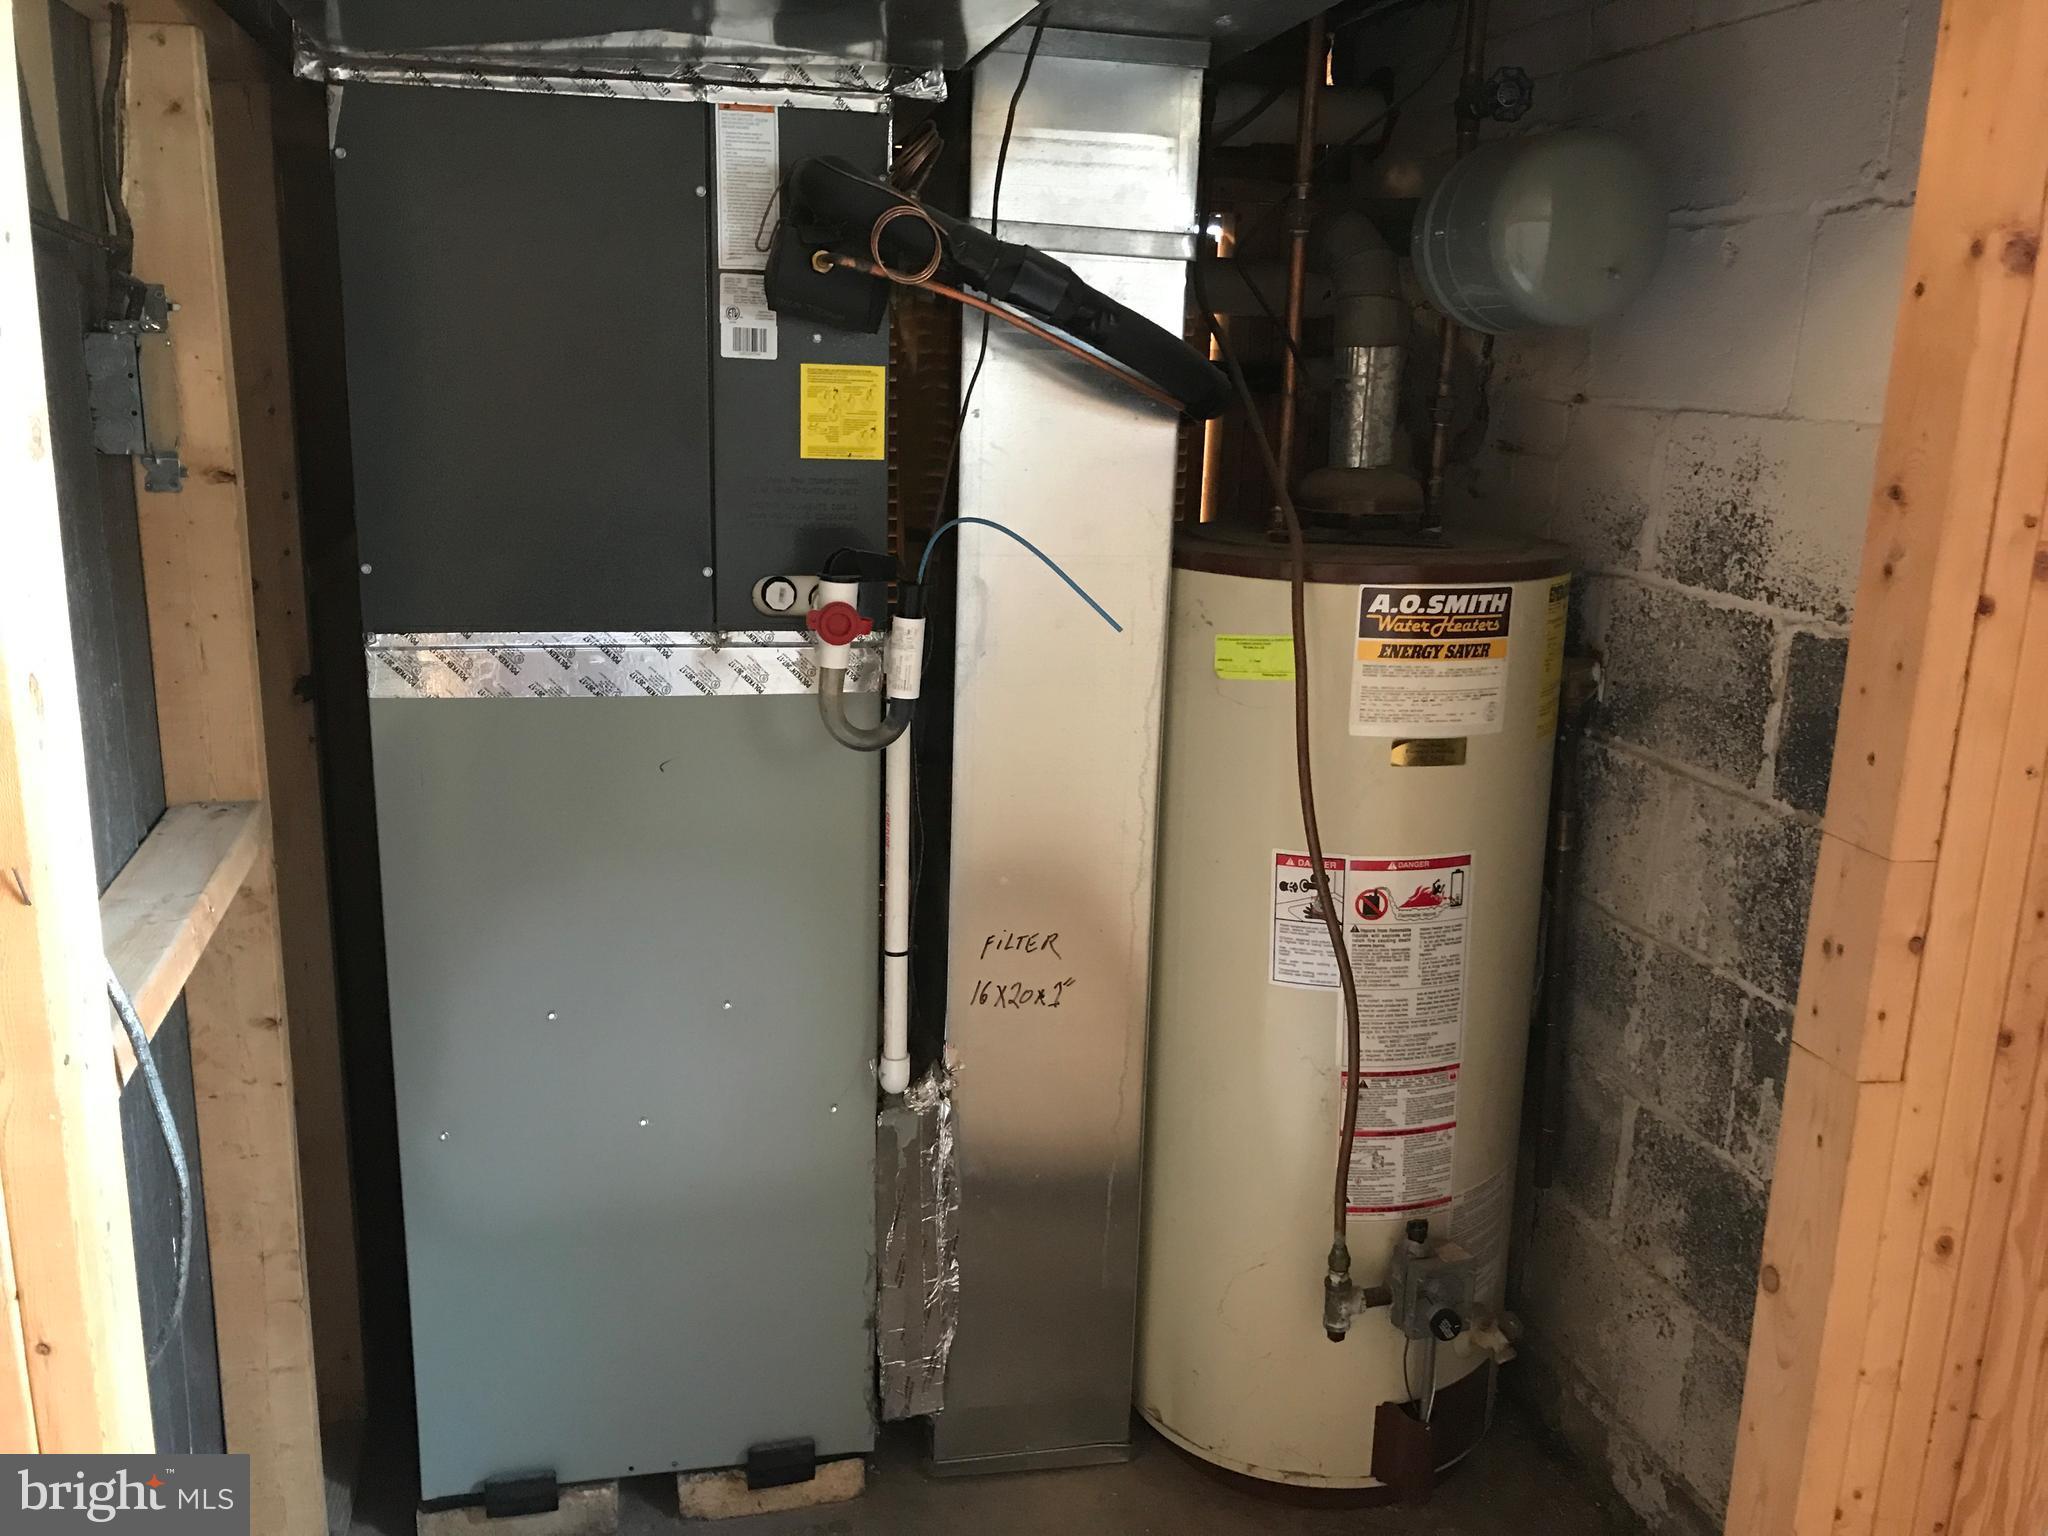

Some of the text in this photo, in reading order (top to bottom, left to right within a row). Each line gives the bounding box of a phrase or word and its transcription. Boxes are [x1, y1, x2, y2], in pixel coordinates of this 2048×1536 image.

[1377, 615, 1500, 638] Water Heaters
[1377, 643, 1491, 659] ENERGY SAVER
[1297, 858, 1337, 869] DAER
[1398, 860, 1430, 869] DANGER
